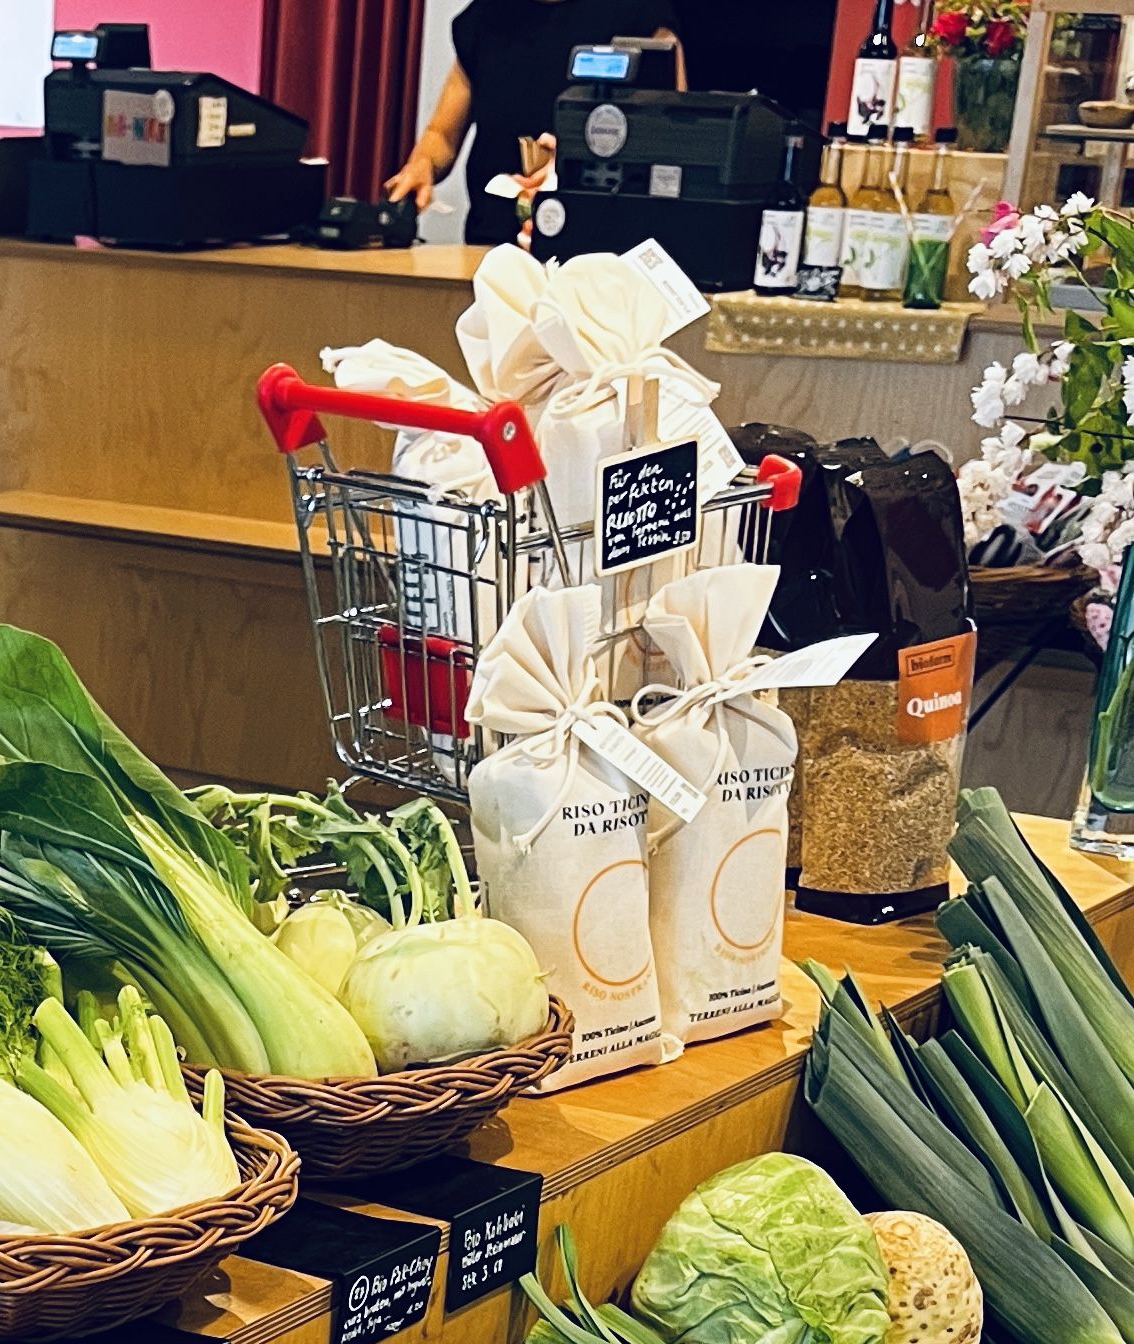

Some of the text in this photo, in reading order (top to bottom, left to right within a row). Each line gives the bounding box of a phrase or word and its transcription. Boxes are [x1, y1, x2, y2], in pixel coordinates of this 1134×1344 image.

[906, 691, 962, 718] Quinoa
[722, 789, 742, 802] DA
[562, 803, 604, 820] RISO
[574, 822, 596, 837] DA
[569, 1047, 608, 1063] ERRENI
